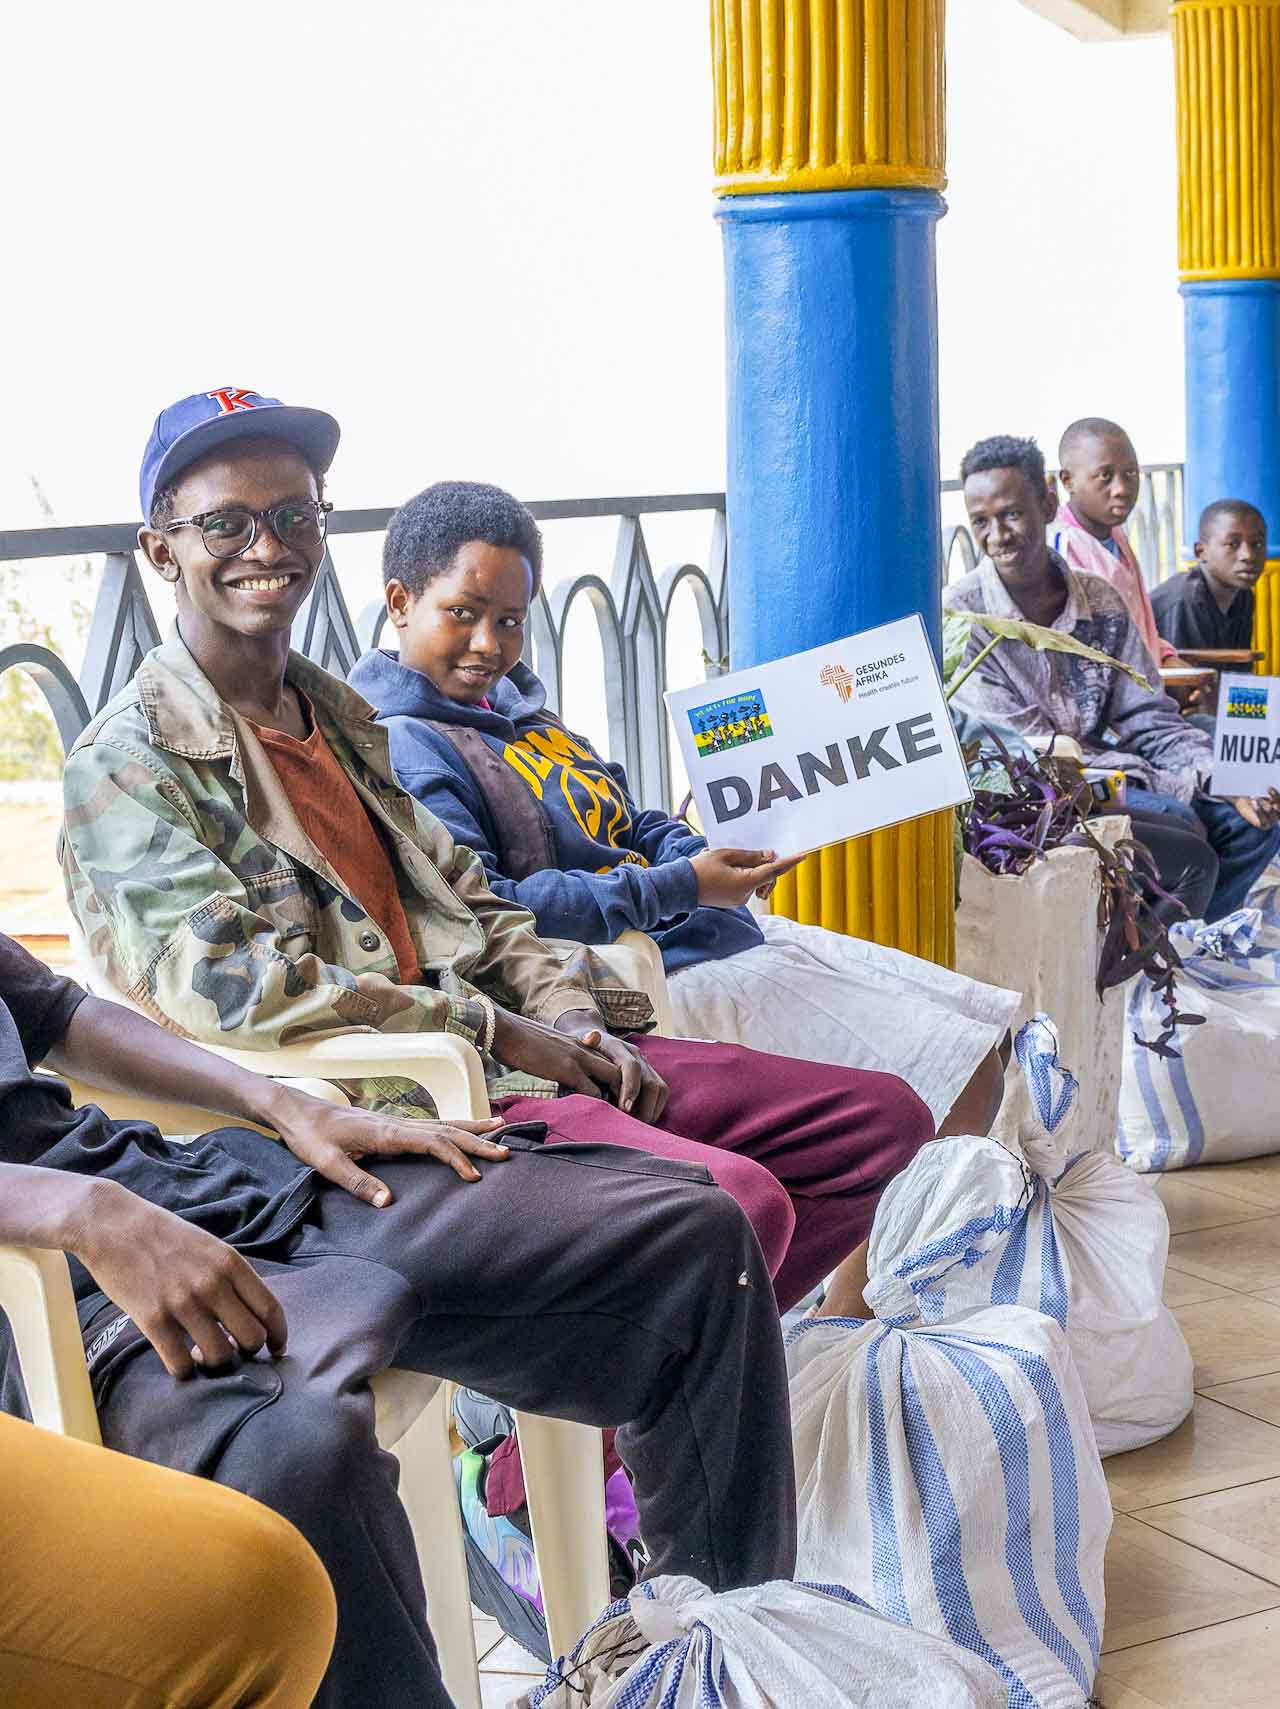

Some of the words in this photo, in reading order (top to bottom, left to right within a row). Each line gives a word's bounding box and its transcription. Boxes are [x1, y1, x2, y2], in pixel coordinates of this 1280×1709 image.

[208, 387, 256, 416] K
[855, 652, 905, 676] GESUNDES
[855, 670, 889, 688] AFRIKA
[706, 712, 943, 824] DANKE
